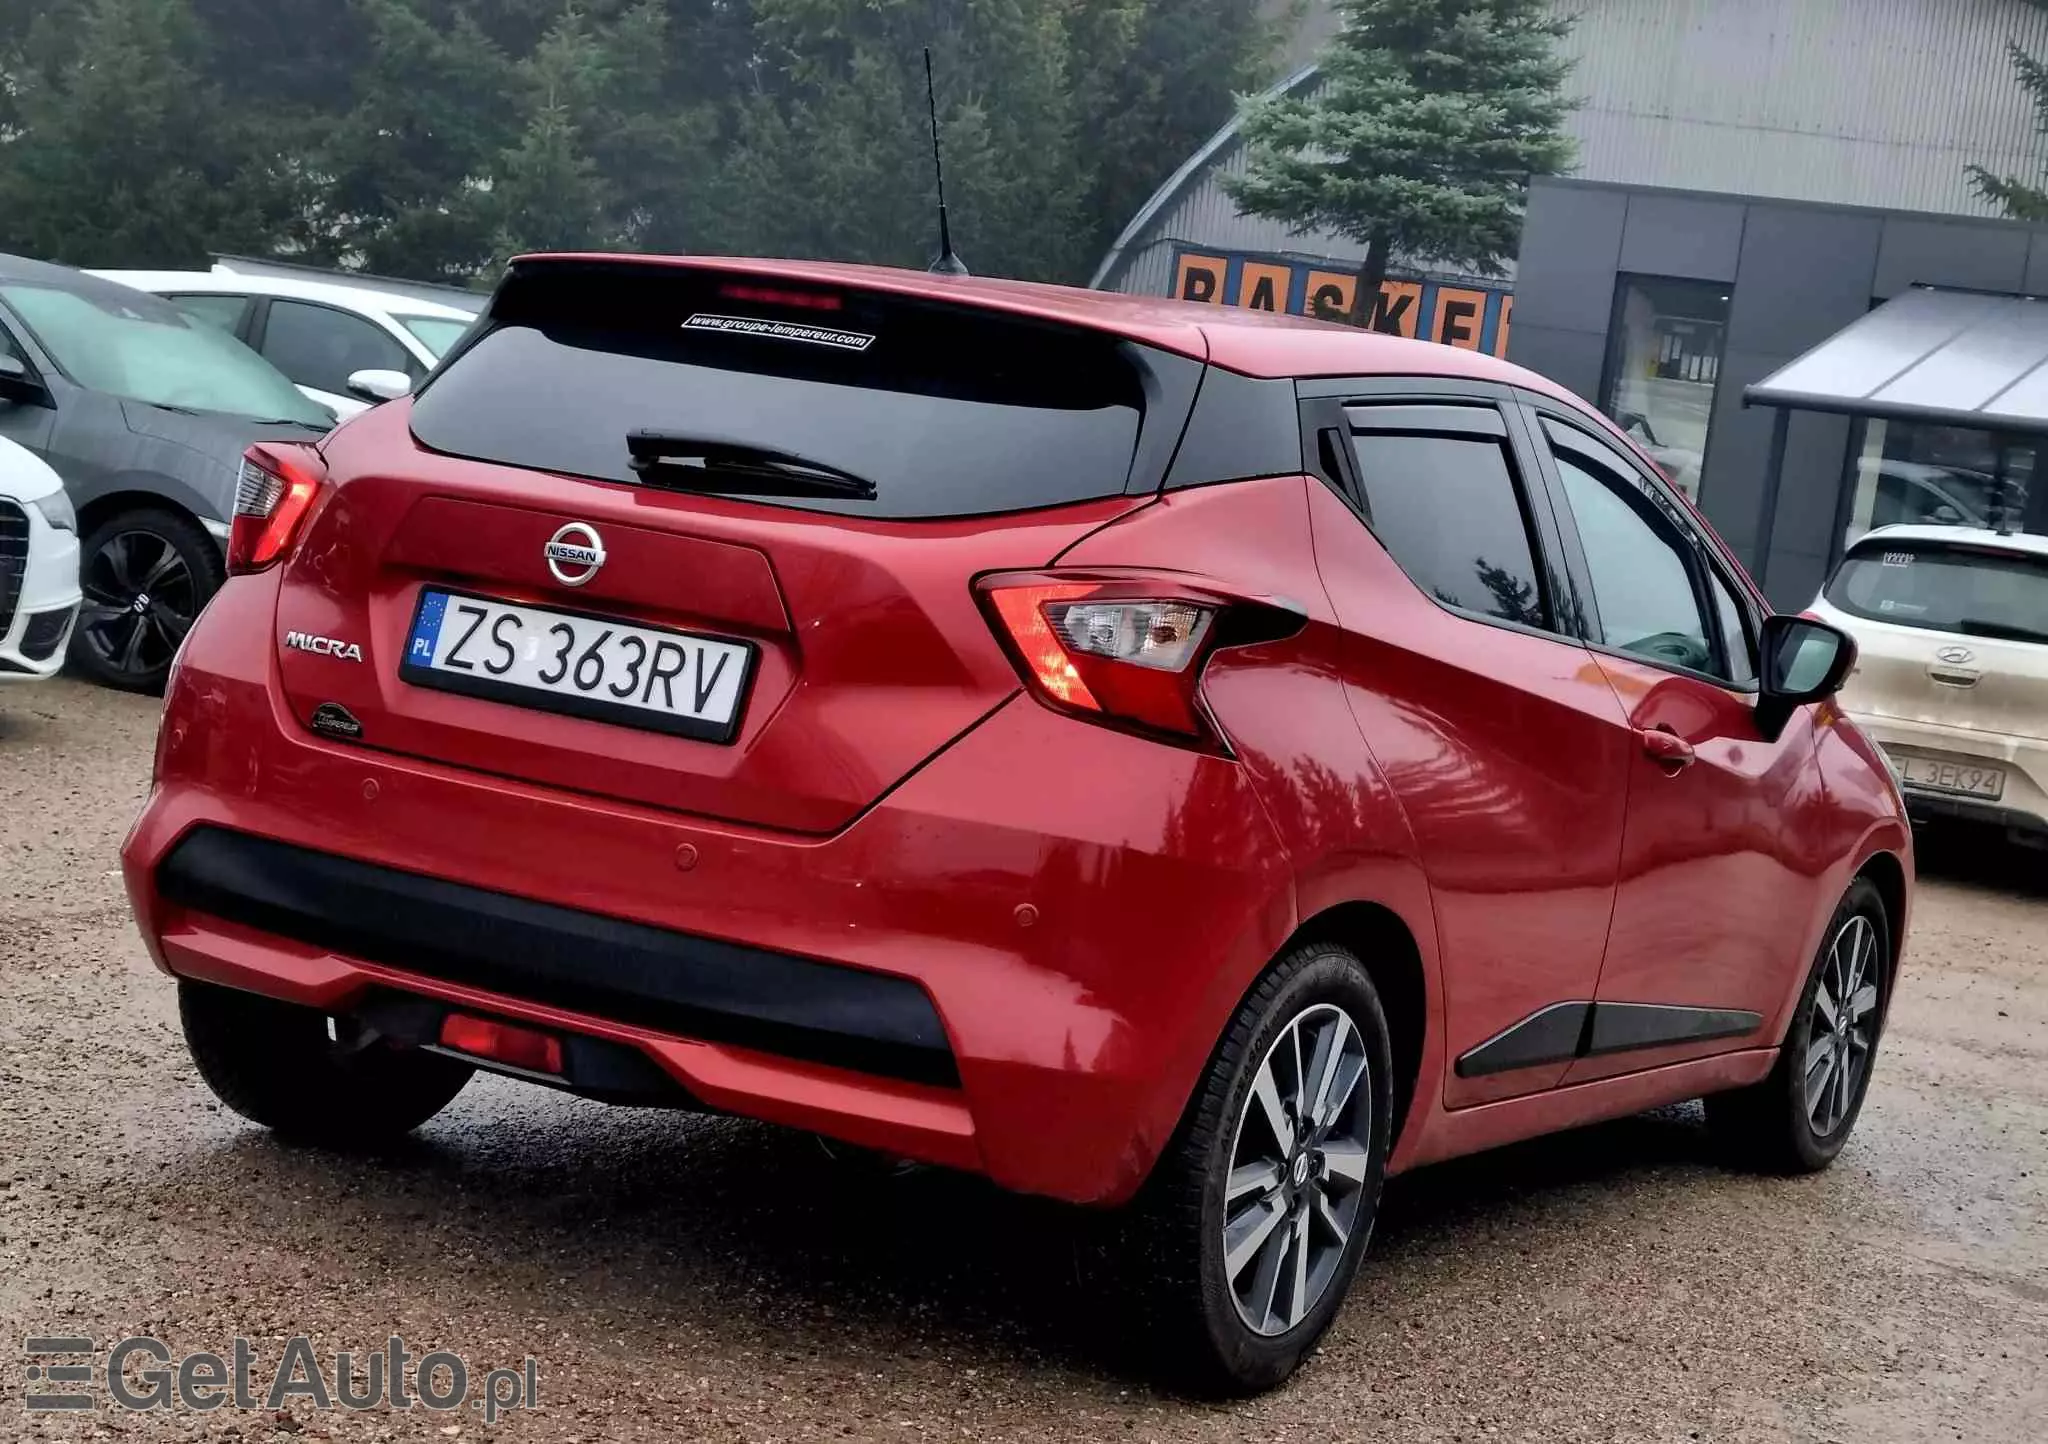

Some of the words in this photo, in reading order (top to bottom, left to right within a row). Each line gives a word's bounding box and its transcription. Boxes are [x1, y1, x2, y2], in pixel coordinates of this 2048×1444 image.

[690, 316, 867, 346] www.groupe-lempereur.com
[547, 545, 597, 562] NISSAN
[286, 631, 362, 662] MICRA
[412, 637, 431, 658] PL
[444, 604, 524, 675] ZS
[537, 622, 730, 713] 363RV
[1926, 762, 1998, 794] 3EK94
